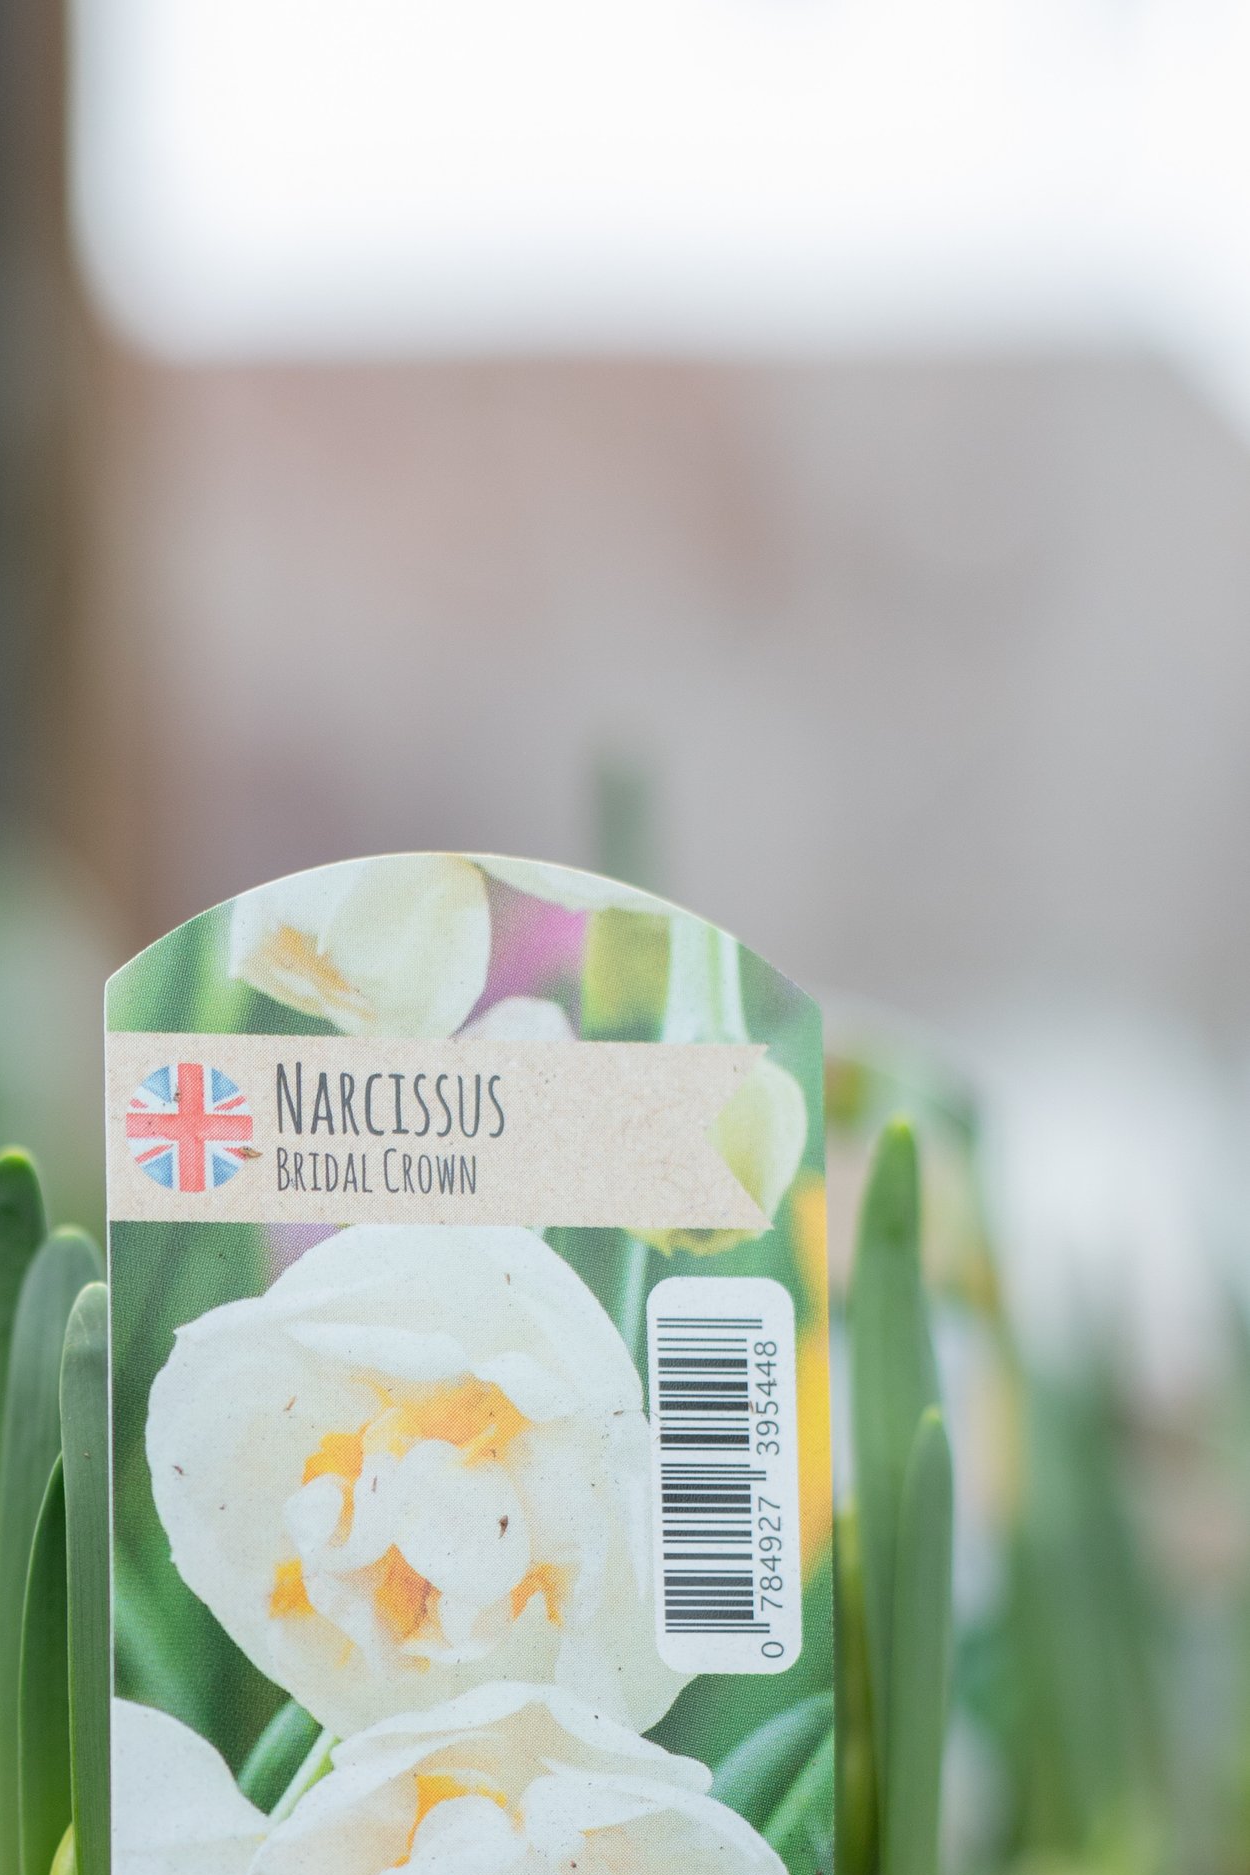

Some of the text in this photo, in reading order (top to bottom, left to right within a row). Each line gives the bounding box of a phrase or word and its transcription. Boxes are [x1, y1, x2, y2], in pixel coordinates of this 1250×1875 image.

[275, 1061, 506, 1138] NARCISSUS
[275, 1146, 478, 1195] BRIDAL CROWN
[754, 1340, 785, 1659] 0 784927 395448
